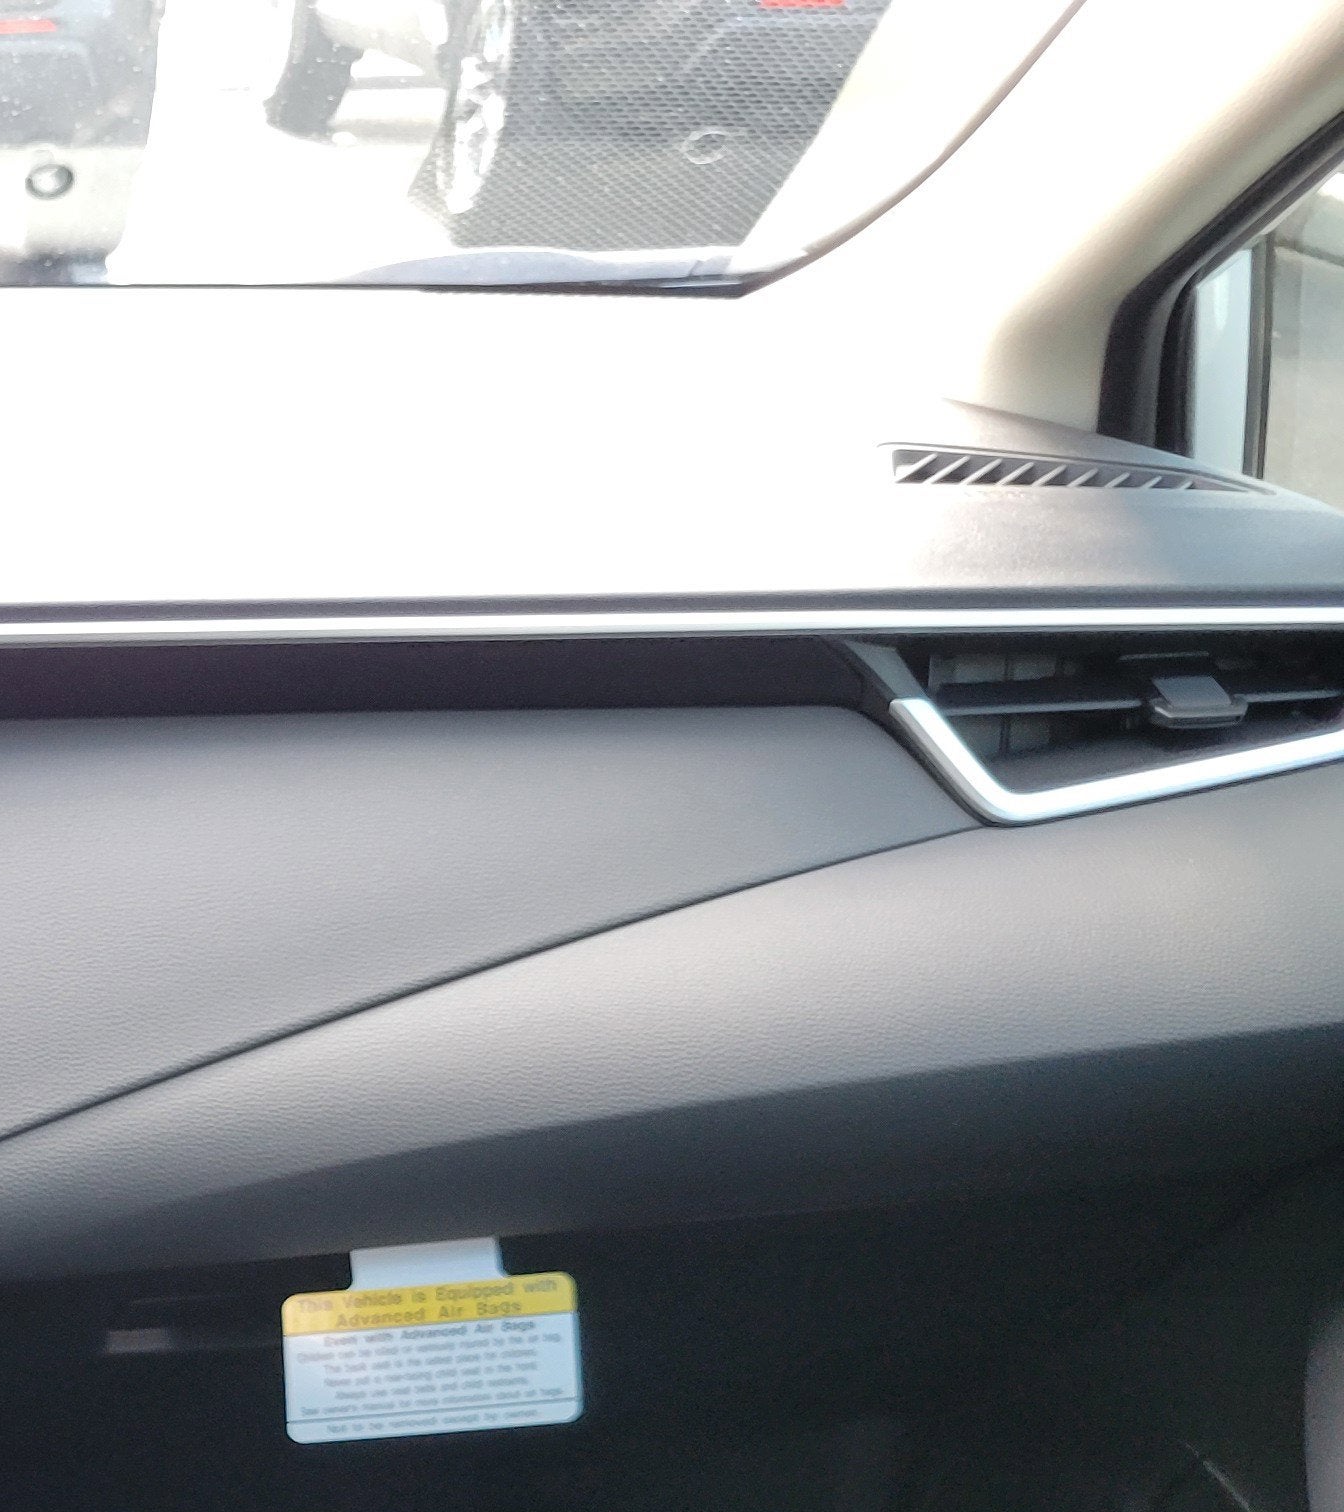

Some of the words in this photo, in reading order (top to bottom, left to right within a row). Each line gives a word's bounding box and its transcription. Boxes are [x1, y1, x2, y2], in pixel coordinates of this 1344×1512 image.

[297, 1299, 333, 1312] This
[344, 1291, 402, 1308] Vehicle
[411, 1291, 426, 1303] is
[435, 1282, 514, 1301] Equipped
[523, 1279, 557, 1293] with
[336, 1308, 426, 1327] Advanced
[438, 1305, 463, 1318] Air
[476, 1302, 522, 1316] Bags
[400, 1325, 468, 1340] Advanced
